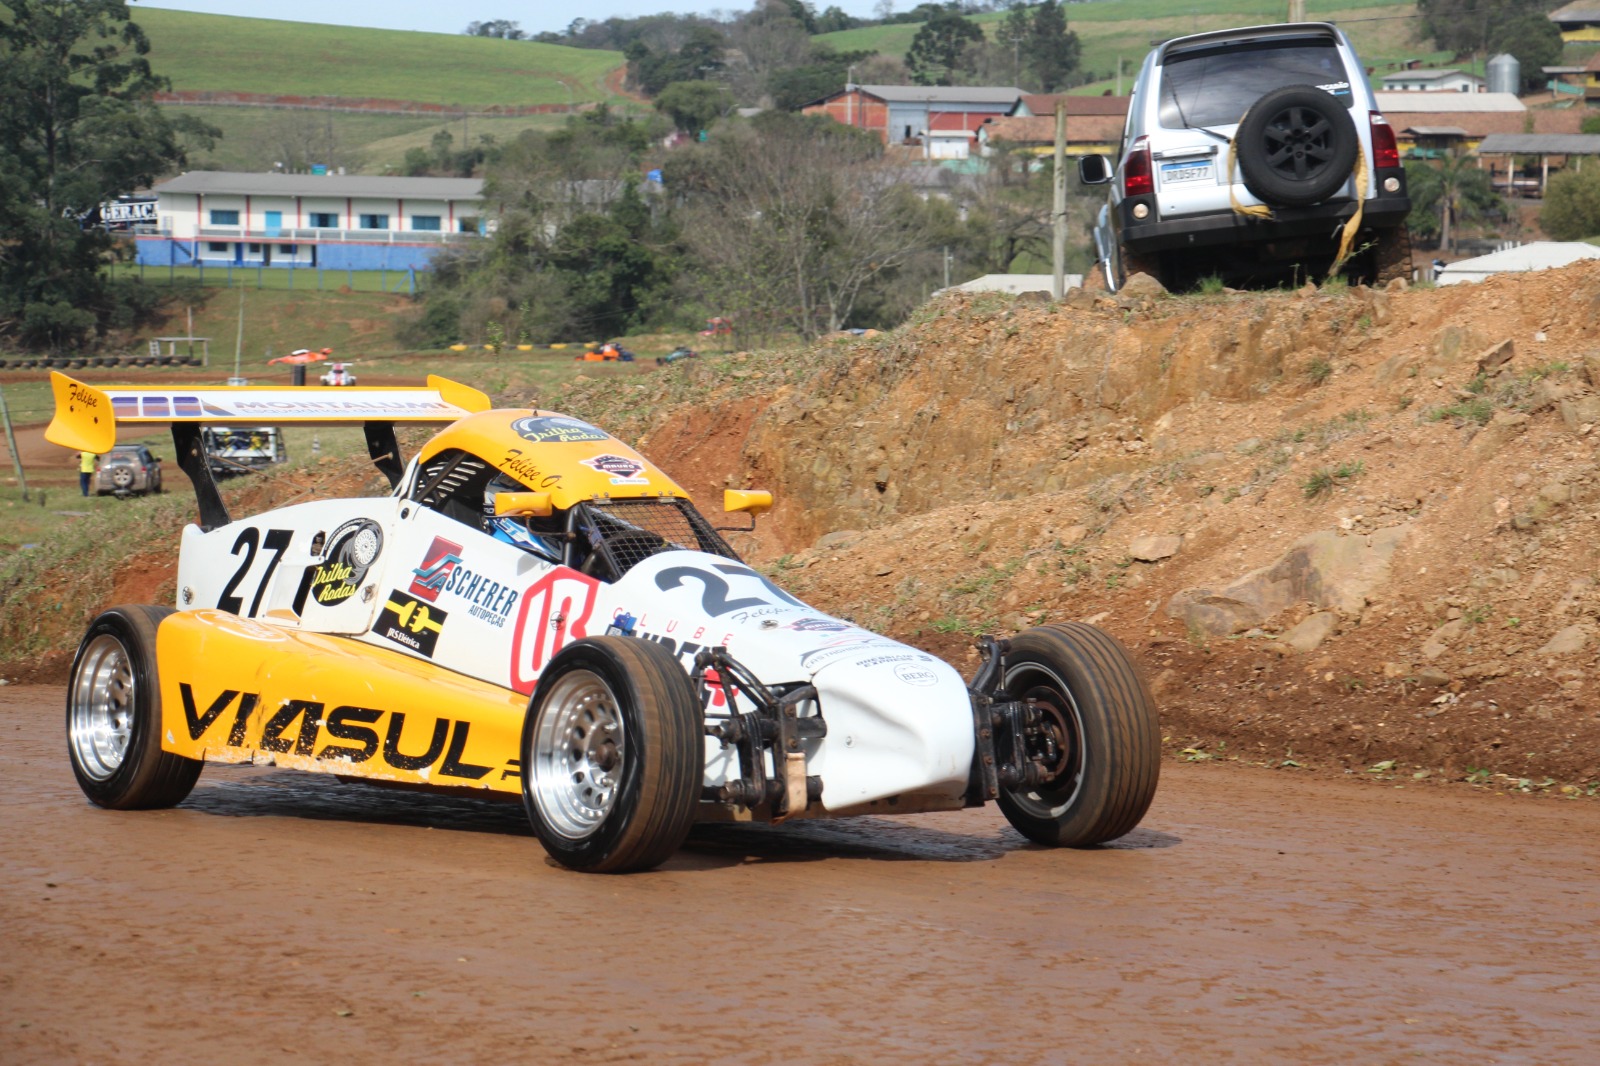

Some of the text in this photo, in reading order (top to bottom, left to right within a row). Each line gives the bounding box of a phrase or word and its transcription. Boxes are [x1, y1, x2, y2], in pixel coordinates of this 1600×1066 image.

[69, 384, 97, 407] Felipe
[524, 427, 583, 443] Trilha
[559, 434, 608, 442] Rodas
[499, 449, 541, 481] Felipe
[217, 527, 294, 618] 27
[311, 562, 352, 587] Trilha
[318, 583, 356, 602] Rodas
[446, 566, 518, 616] SCHERER
[468, 604, 506, 628] AUTOPEÇAS
[613, 607, 733, 646] CLUBE
[901, 672, 934, 681] BERG
[179, 682, 495, 780] VIASUL
